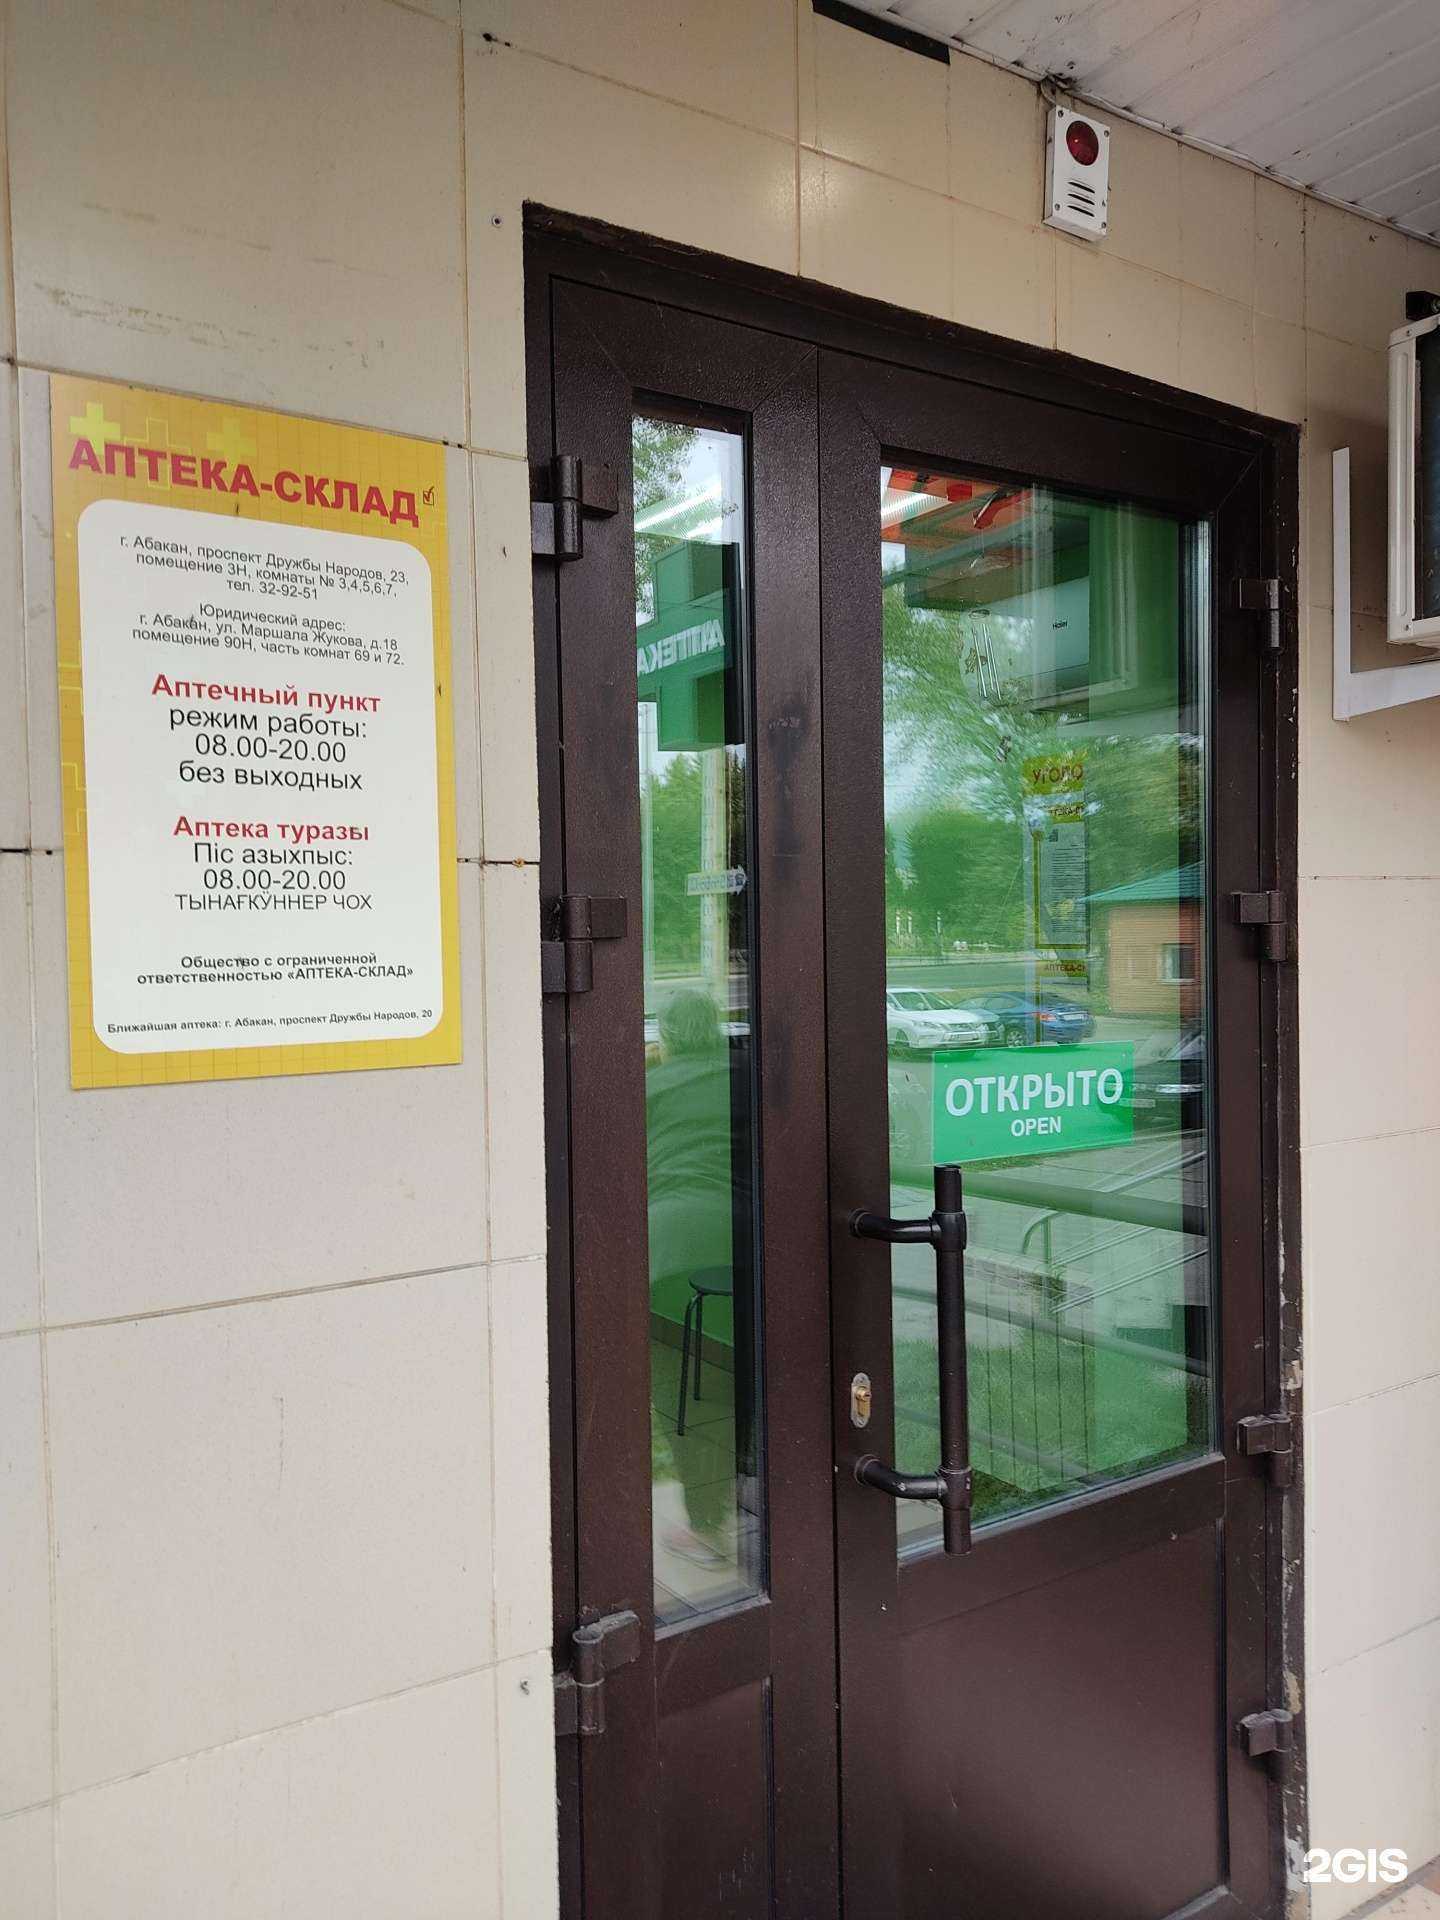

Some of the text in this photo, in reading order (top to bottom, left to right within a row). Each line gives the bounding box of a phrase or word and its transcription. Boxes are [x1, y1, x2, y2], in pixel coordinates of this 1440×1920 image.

[68, 438, 420, 529] АПТЕКА-СКЛАД
[120, 535, 409, 585] г. Абакан, проспект Дружбы Народов, 23,
[136, 553, 397, 598] помещение 3Н, комнаты № 3,4,5,6,7,
[226, 579, 318, 600] тел. 32-92-51
[139, 613, 398, 651] г. Абакан, ул. Маршала Жукова, д.18
[200, 603, 346, 633] Юридический адрес:
[132, 628, 405, 666] помещение 90Н, часть комнат 69 и 72.
[151, 673, 381, 715] Аптечный пункт
[169, 708, 367, 738] режим работы:
[195, 732, 347, 763] 08.00-20.00
[179, 760, 363, 792] без выходных
[173, 815, 369, 845] Аптека туразы
[242, 847, 353, 866] азыхпыс:
[203, 868, 346, 890] 08.00-20.00
[333, 894, 373, 911] ЧОХ
[137, 964, 414, 985] ответственностью «АПТЕКА-СКЛАД»
[181, 952, 378, 970] Общество с ограниченной
[107, 1009, 433, 1034] Ближайшая аптека: г. Абакан, проспект Дружбы Народов, 20
[945, 1068, 1124, 1117] ОТКРЫТО
[1011, 1116, 1062, 1137] OPEN
